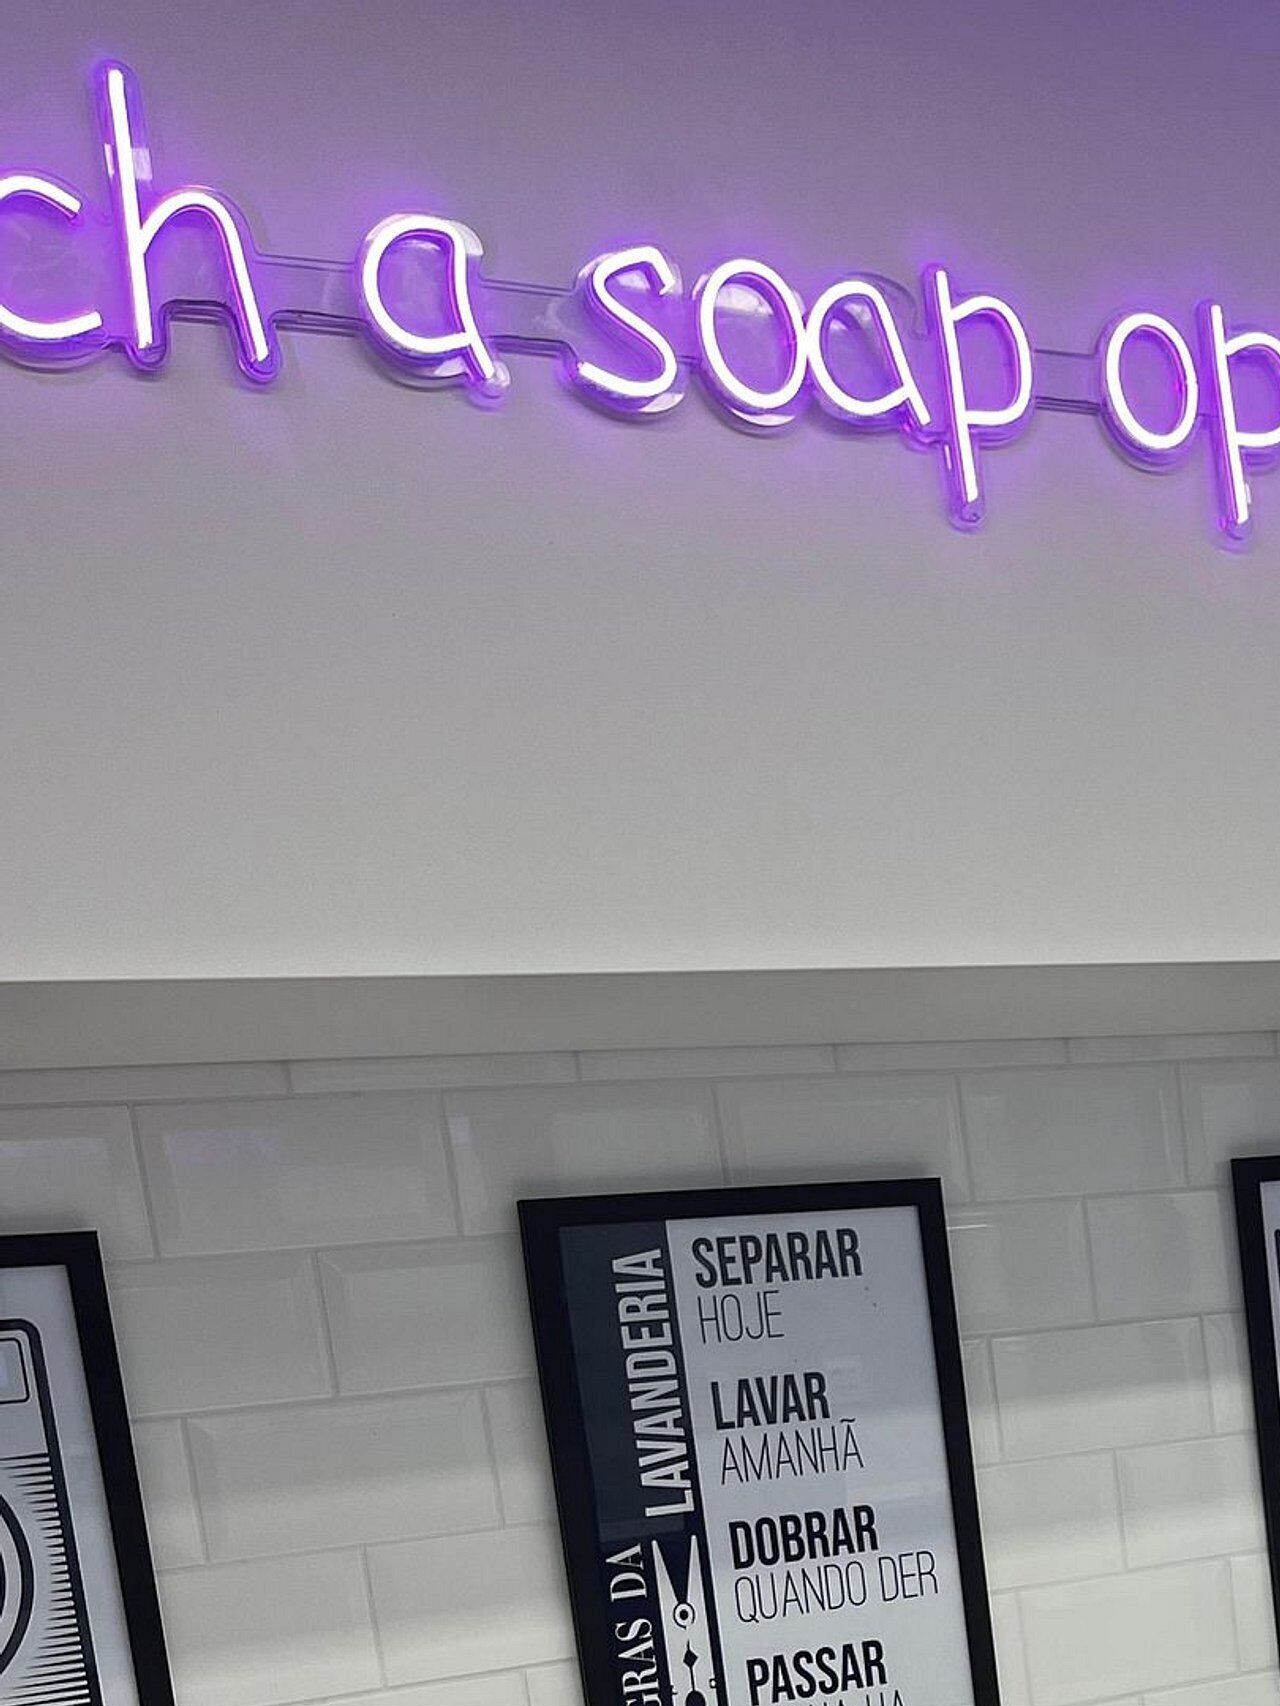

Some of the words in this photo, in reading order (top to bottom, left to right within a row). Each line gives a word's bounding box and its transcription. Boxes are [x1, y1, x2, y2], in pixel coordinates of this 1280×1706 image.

[362, 214, 495, 378] a
[578, 245, 1033, 502] soap
[691, 1228, 863, 1289] SEPARAR
[698, 1292, 785, 1343] HOJE
[612, 1248, 695, 1517] LAVANDERIA
[711, 1371, 830, 1429] LAVAR
[721, 1419, 864, 1484] AMANHÃ
[728, 1505, 879, 1569] DOBRAR
[609, 1544, 643, 1602] DA
[734, 1561, 868, 1622] QUANDO
[878, 1552, 939, 1601] DER
[746, 1640, 888, 1706] PASSAR
